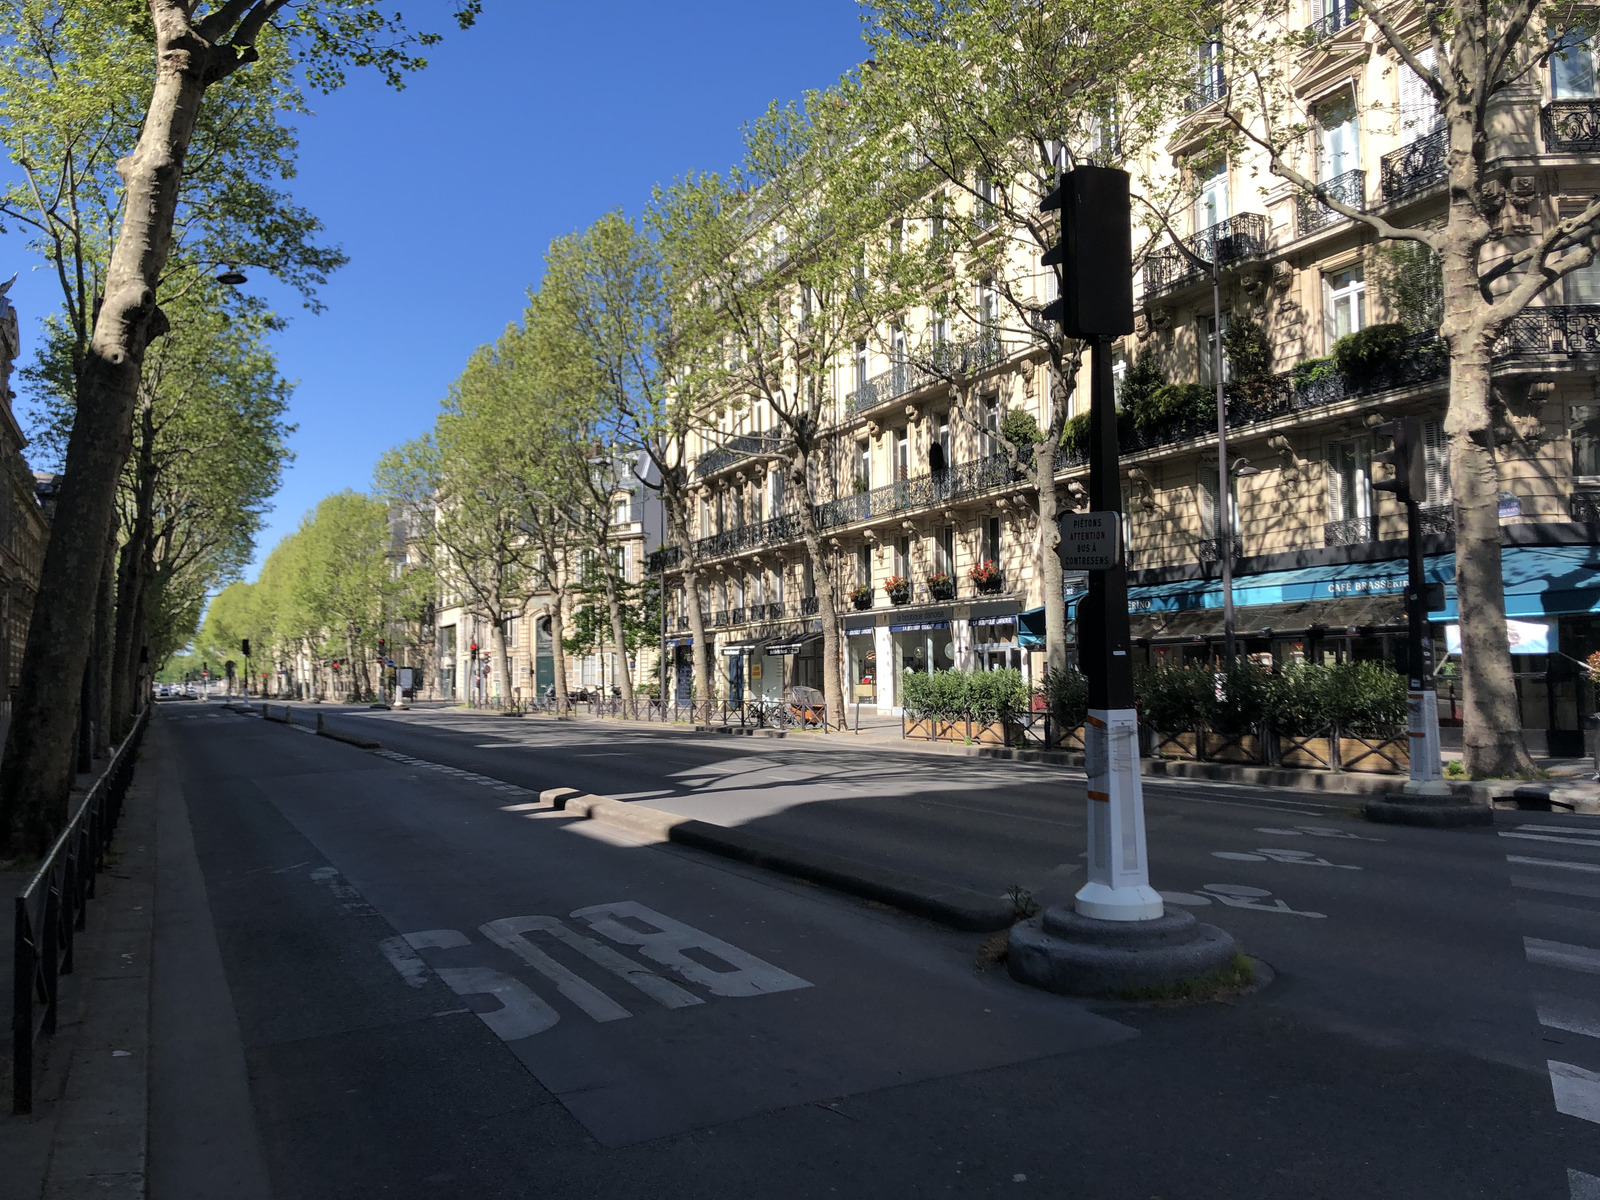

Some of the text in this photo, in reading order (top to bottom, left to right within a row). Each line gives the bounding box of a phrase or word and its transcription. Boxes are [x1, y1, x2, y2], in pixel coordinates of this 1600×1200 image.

[1073, 518, 1102, 528] PIÉTONS
[1070, 531, 1106, 540] ATTENTION
[1077, 542, 1097, 553] BUS À
[1065, 556, 1109, 565] CONTRESENS
[1328, 581, 1352, 593] CAFÉ
[1127, 600, 1151, 610] ERINO
[378, 900, 816, 1042] BUS
